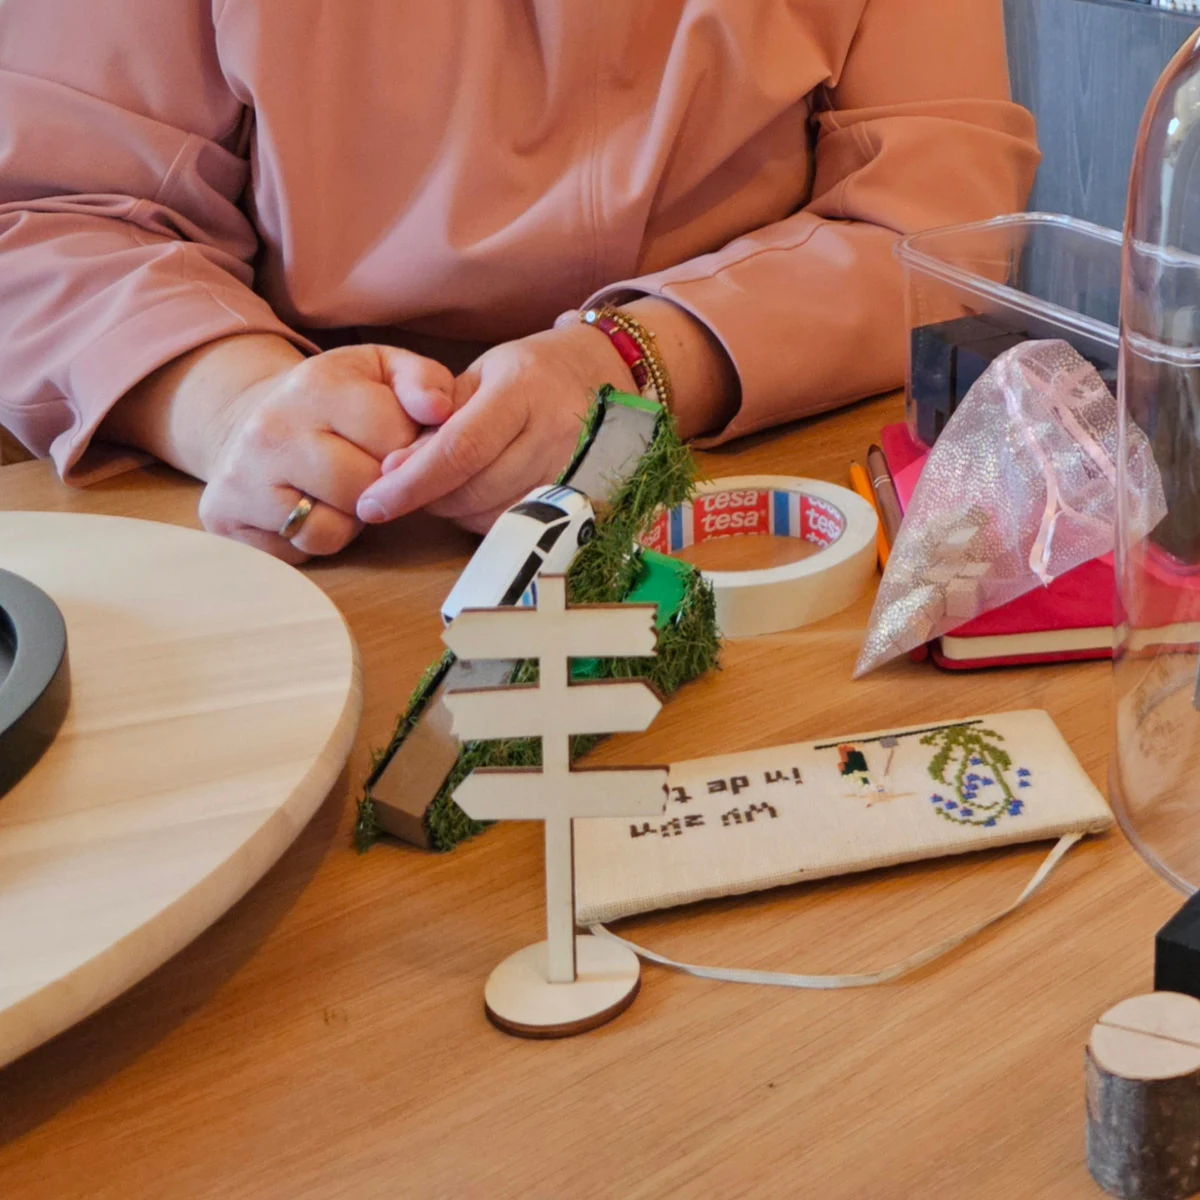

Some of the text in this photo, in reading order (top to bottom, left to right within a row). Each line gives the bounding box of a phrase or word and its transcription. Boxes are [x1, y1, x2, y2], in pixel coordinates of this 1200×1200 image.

[701, 490, 759, 512] tesa
[701, 509, 759, 533] tesa
[804, 507, 842, 541] tesa
[671, 786, 693, 804] t
[706, 775, 751, 796] de
[629, 801, 779, 839] Wij zijn
